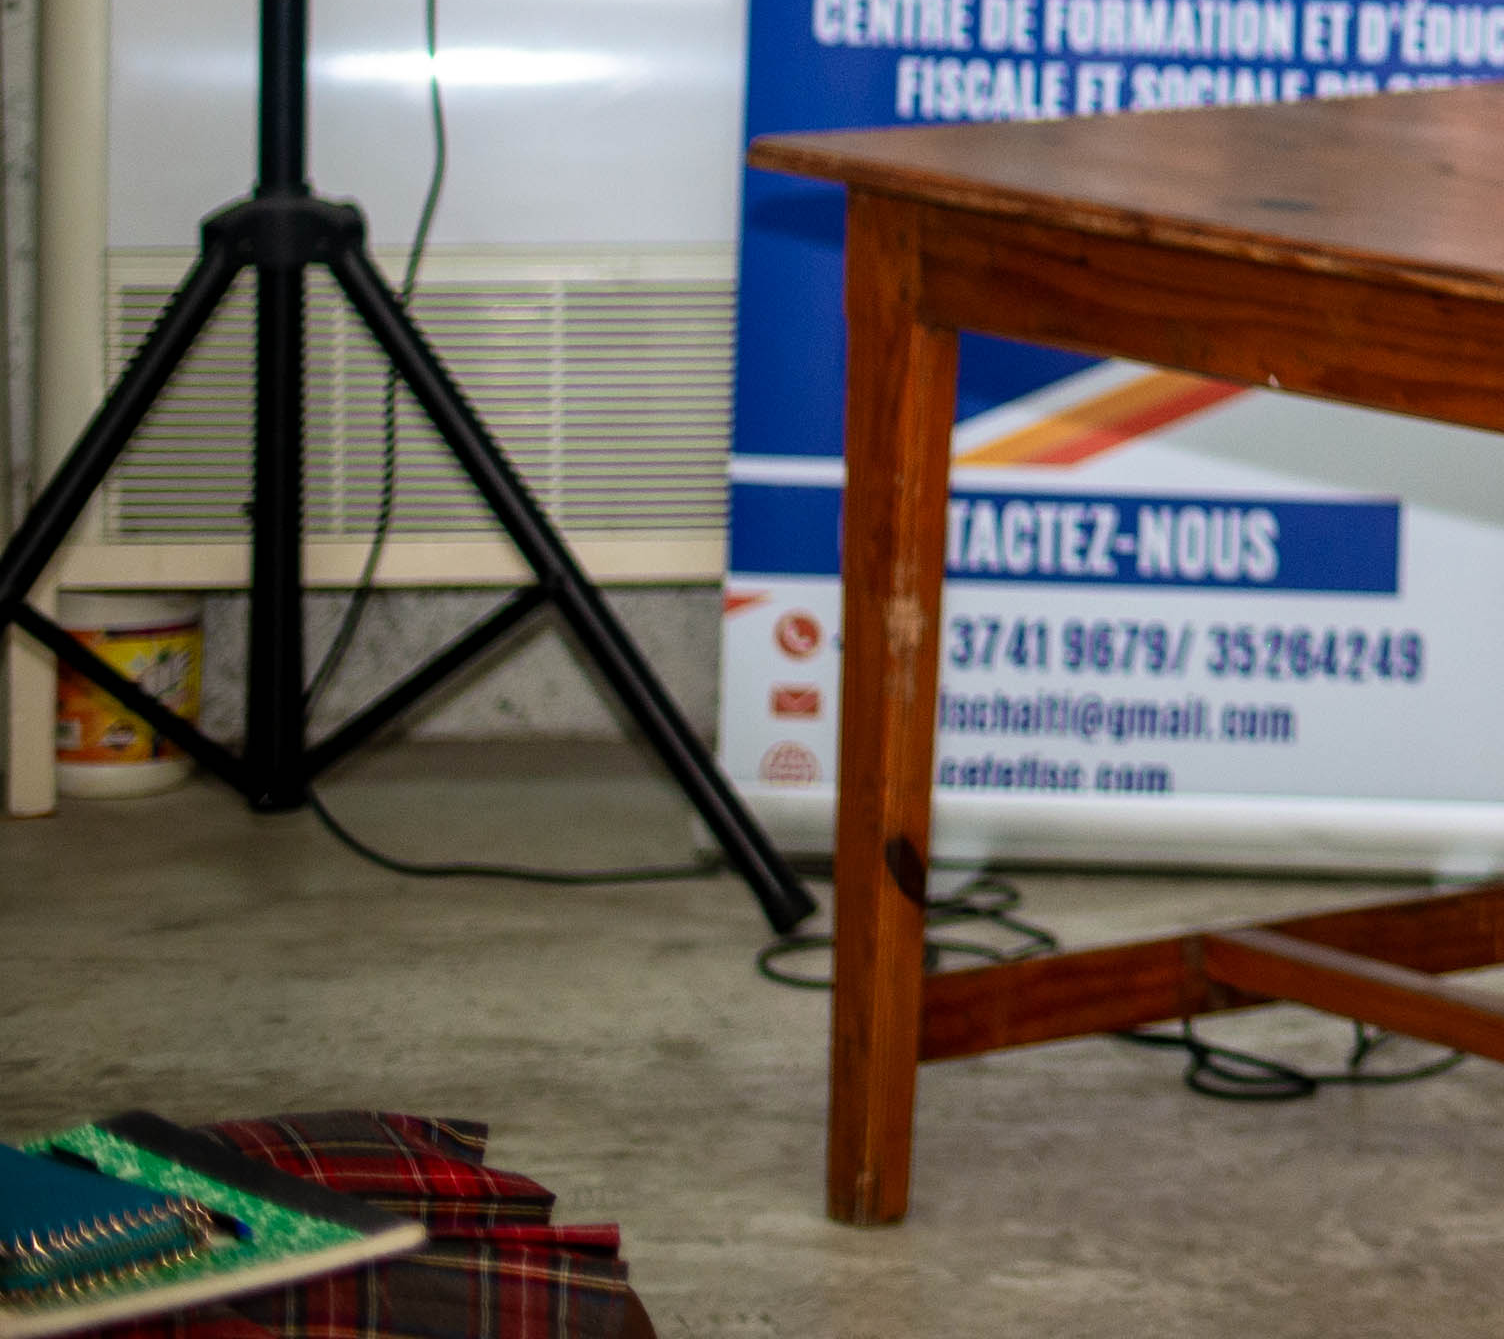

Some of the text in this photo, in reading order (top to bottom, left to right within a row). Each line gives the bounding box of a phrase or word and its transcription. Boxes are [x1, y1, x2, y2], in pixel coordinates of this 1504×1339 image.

[897, 55, 1070, 122] FISCALE
[1075, 61, 1126, 118] ET
[948, 499, 1279, 582] TACTEZ-NOUS
[952, 617, 1049, 672] 3741
[1207, 624, 1425, 684] 35264249
